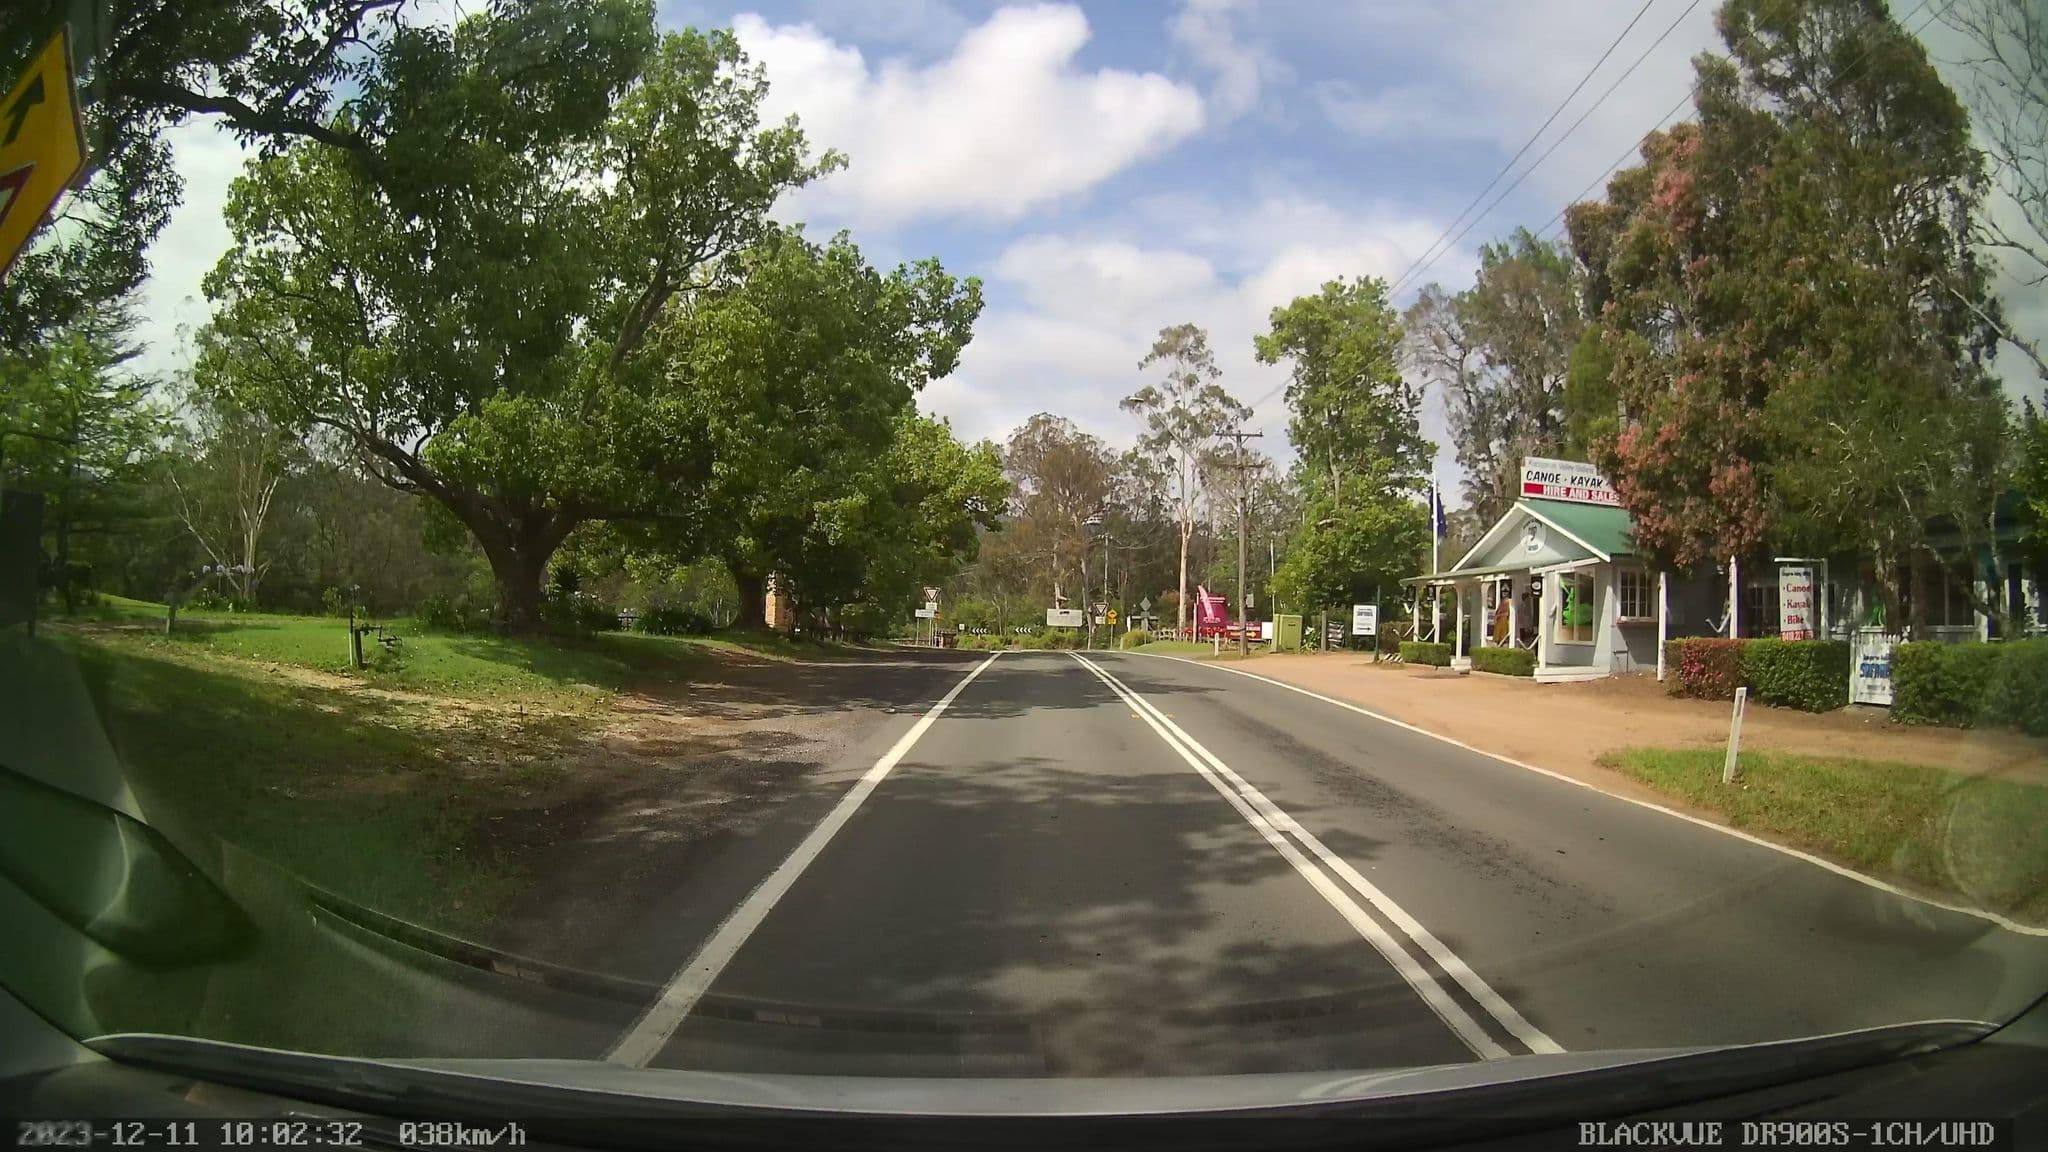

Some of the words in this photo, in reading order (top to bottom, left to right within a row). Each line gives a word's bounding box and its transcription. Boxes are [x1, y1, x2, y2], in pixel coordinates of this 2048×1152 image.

[1526, 470, 1561, 484] CANOE
[1570, 475, 1604, 489] KAYAK
[1543, 485, 1567, 497] HIRE
[1568, 487, 1589, 500] AND
[1591, 490, 1620, 503] SALES
[1787, 615, 1804, 625] Bike
